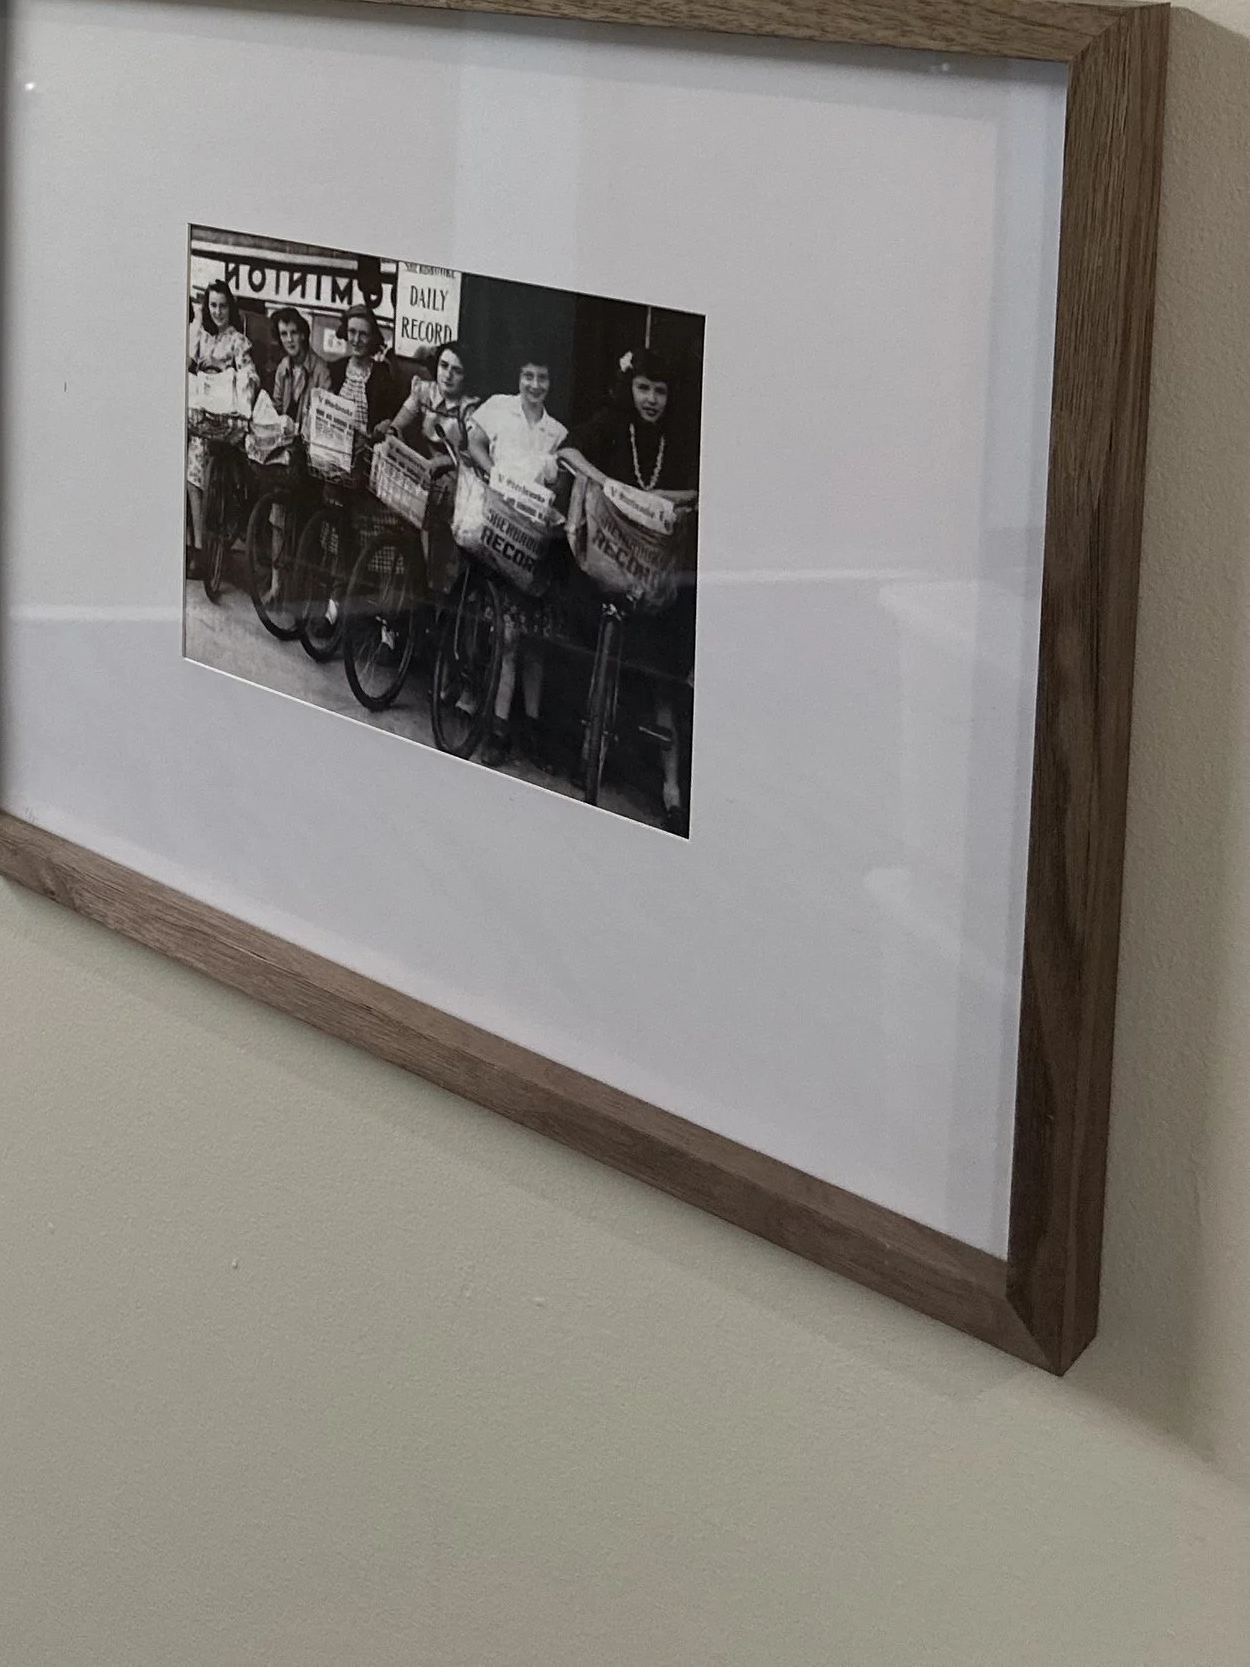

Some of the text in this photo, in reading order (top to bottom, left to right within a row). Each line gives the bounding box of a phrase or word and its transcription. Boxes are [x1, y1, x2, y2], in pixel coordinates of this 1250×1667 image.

[410, 285, 450, 311] DAILY
[401, 316, 452, 345] RECORD
[480, 525, 536, 572] RECOR
